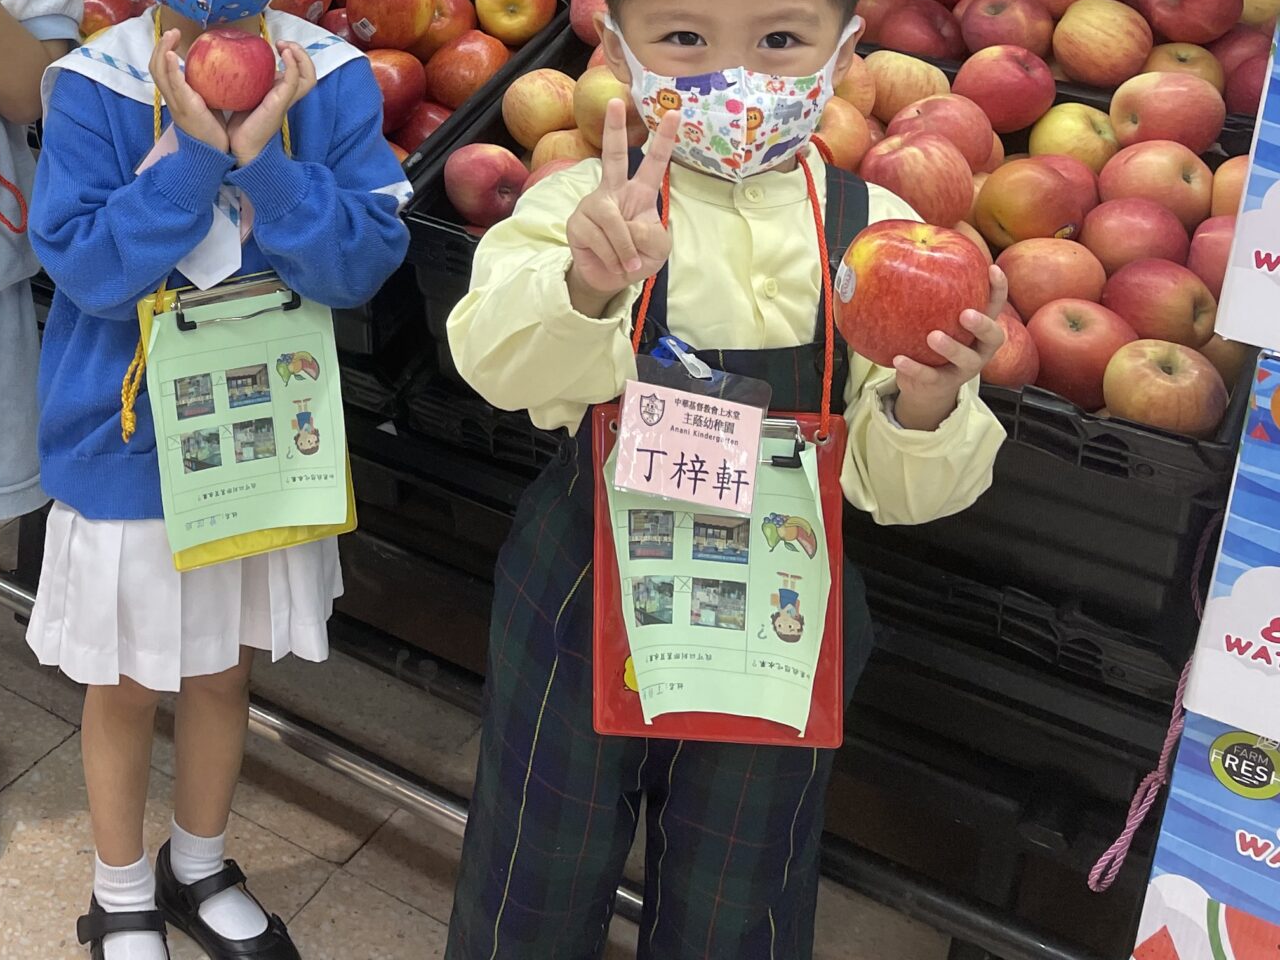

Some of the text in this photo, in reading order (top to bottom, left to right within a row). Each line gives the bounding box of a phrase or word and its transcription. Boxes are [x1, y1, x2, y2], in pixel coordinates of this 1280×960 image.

[670, 424, 691, 436] Anani
[636, 447, 750, 504] 丁梓軒
[1225, 633, 1280, 668] WA
[1233, 744, 1269, 766] FARM
